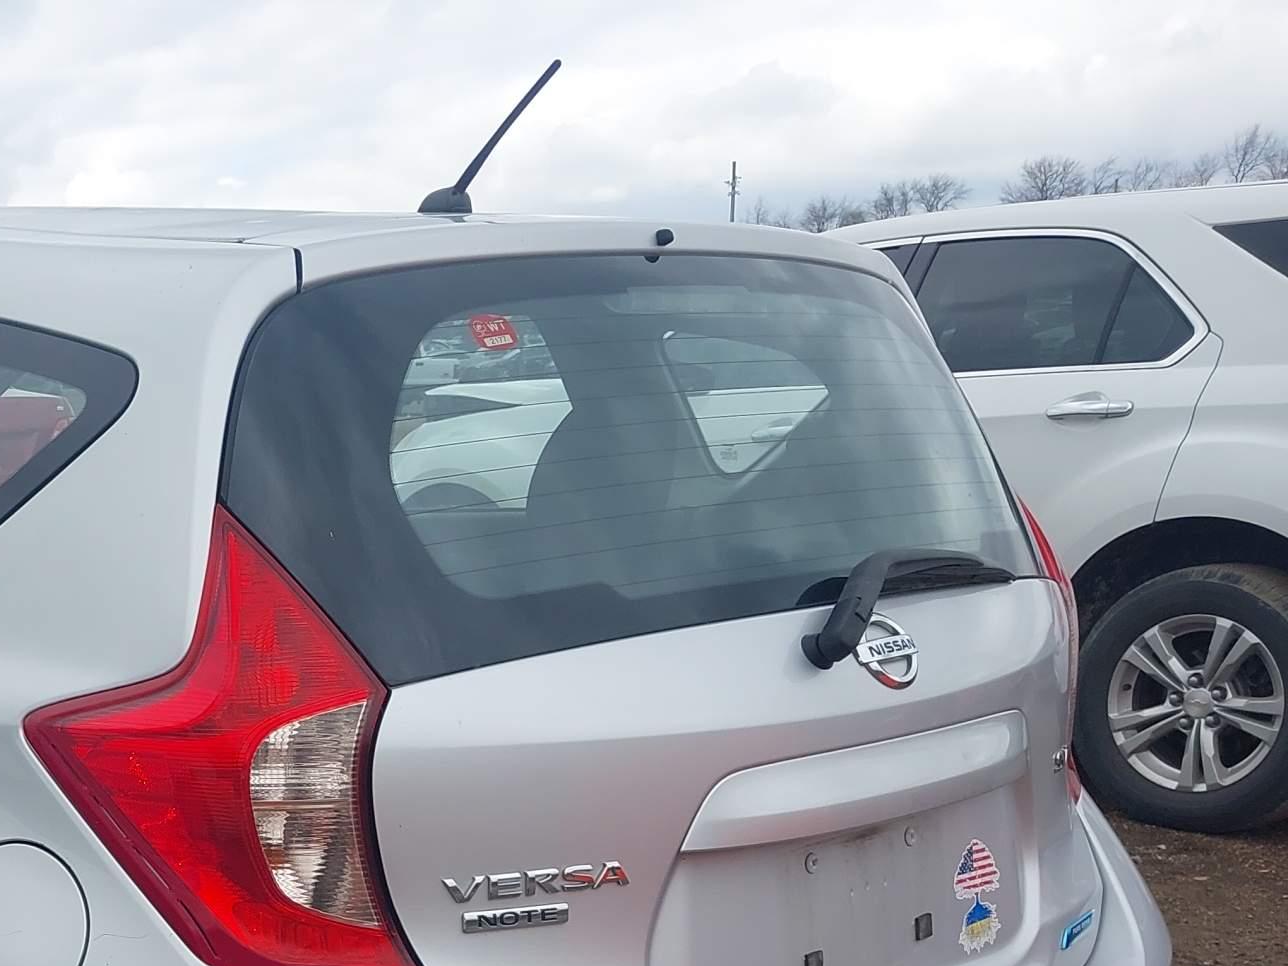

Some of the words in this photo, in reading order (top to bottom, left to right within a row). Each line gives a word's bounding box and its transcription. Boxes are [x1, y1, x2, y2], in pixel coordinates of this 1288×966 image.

[868, 638, 916, 657] NISSAN
[441, 861, 630, 904] VERSA
[478, 907, 559, 928] NOTE
